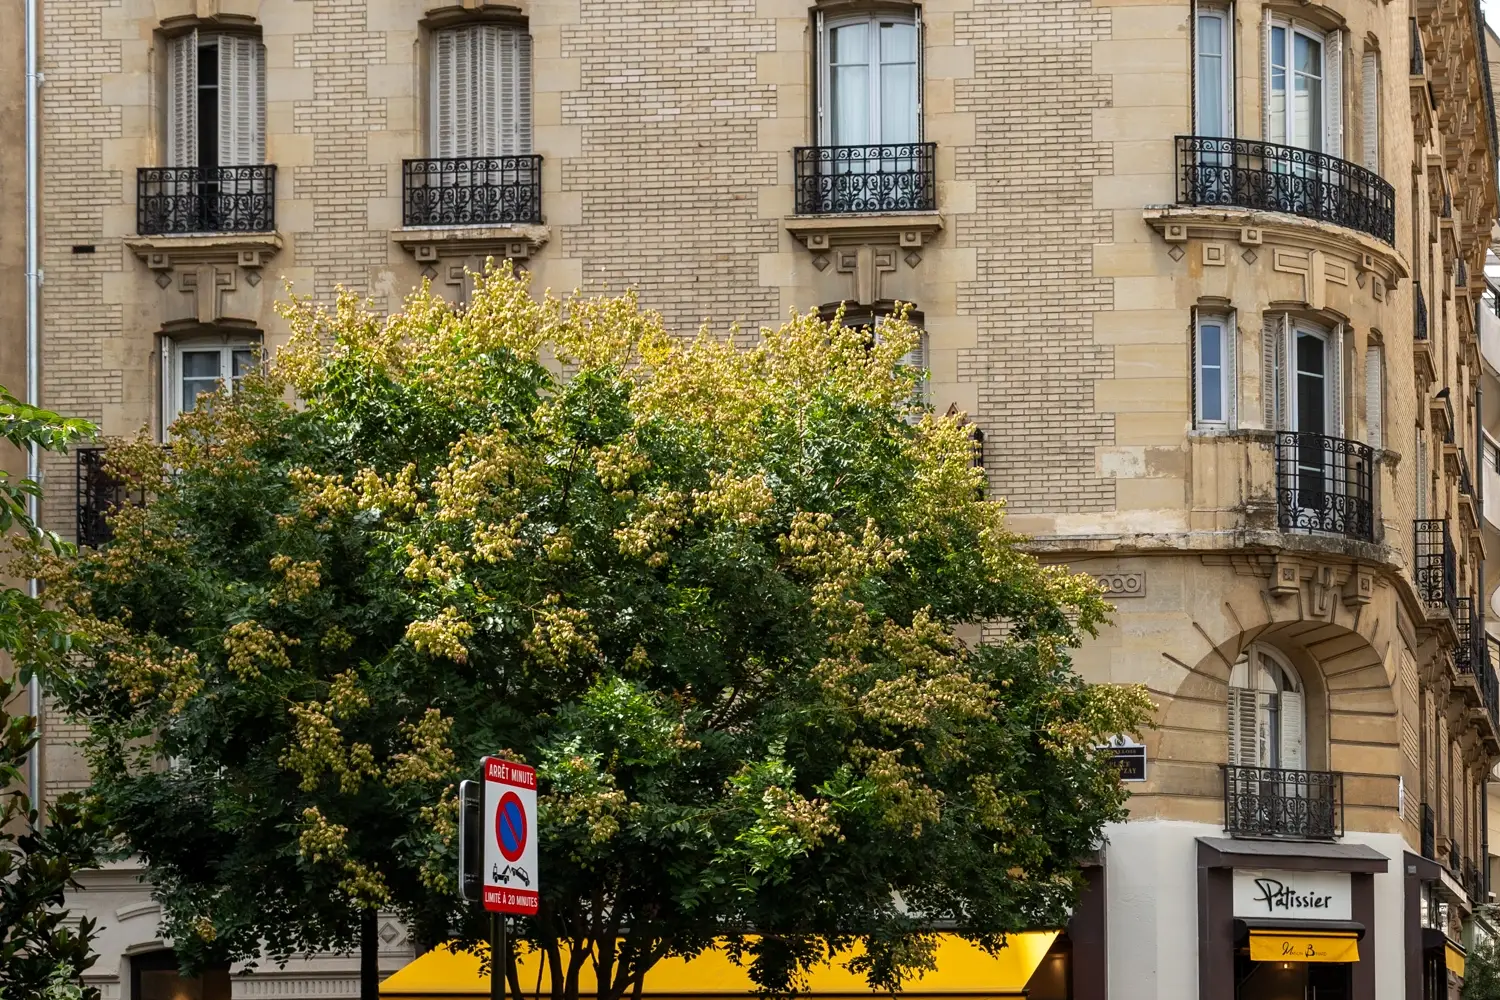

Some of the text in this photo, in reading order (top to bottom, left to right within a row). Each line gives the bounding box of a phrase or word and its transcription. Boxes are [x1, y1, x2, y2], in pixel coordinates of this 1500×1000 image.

[489, 763, 534, 786] ARRÊT MINUTE
[484, 890, 538, 908] LIMITÉ À 20 MINUTES
